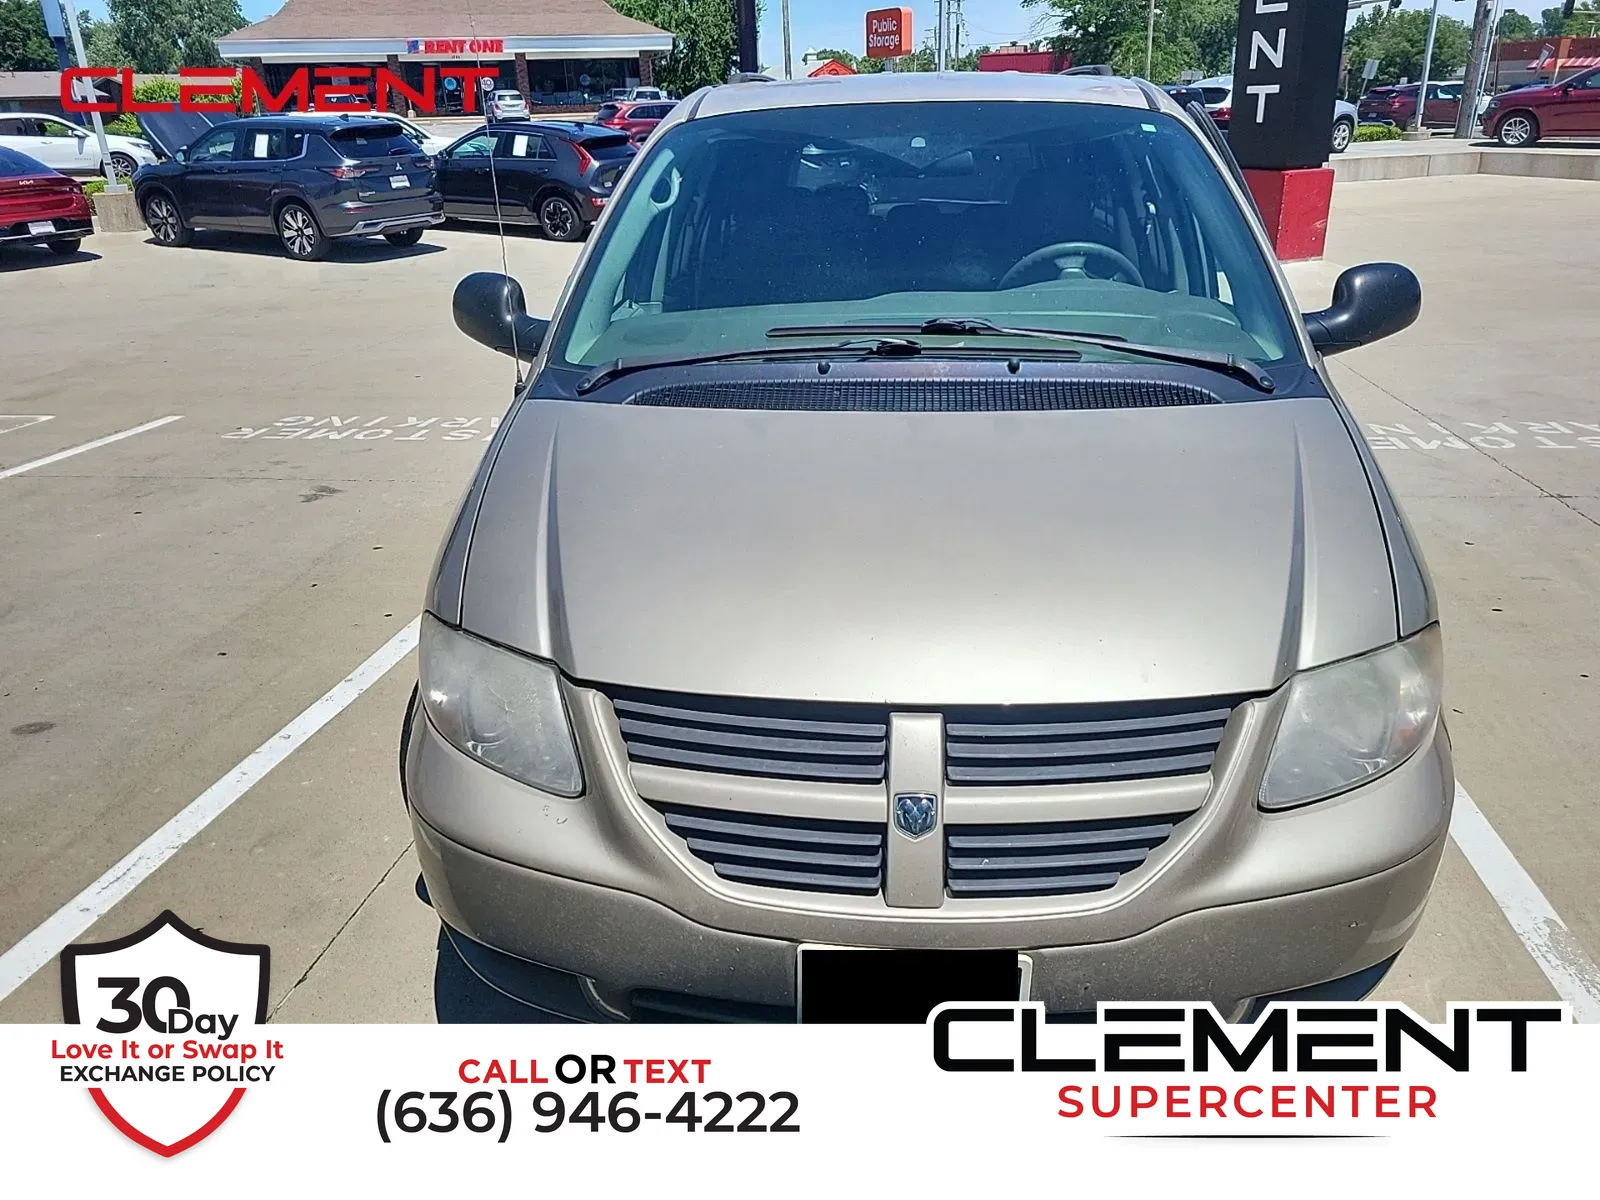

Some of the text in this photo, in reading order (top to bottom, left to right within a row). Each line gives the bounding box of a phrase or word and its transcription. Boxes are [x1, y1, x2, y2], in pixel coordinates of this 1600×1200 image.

[872, 17, 898, 33] Public
[424, 39, 503, 54] RENT ONE
[868, 33, 900, 50] Storage
